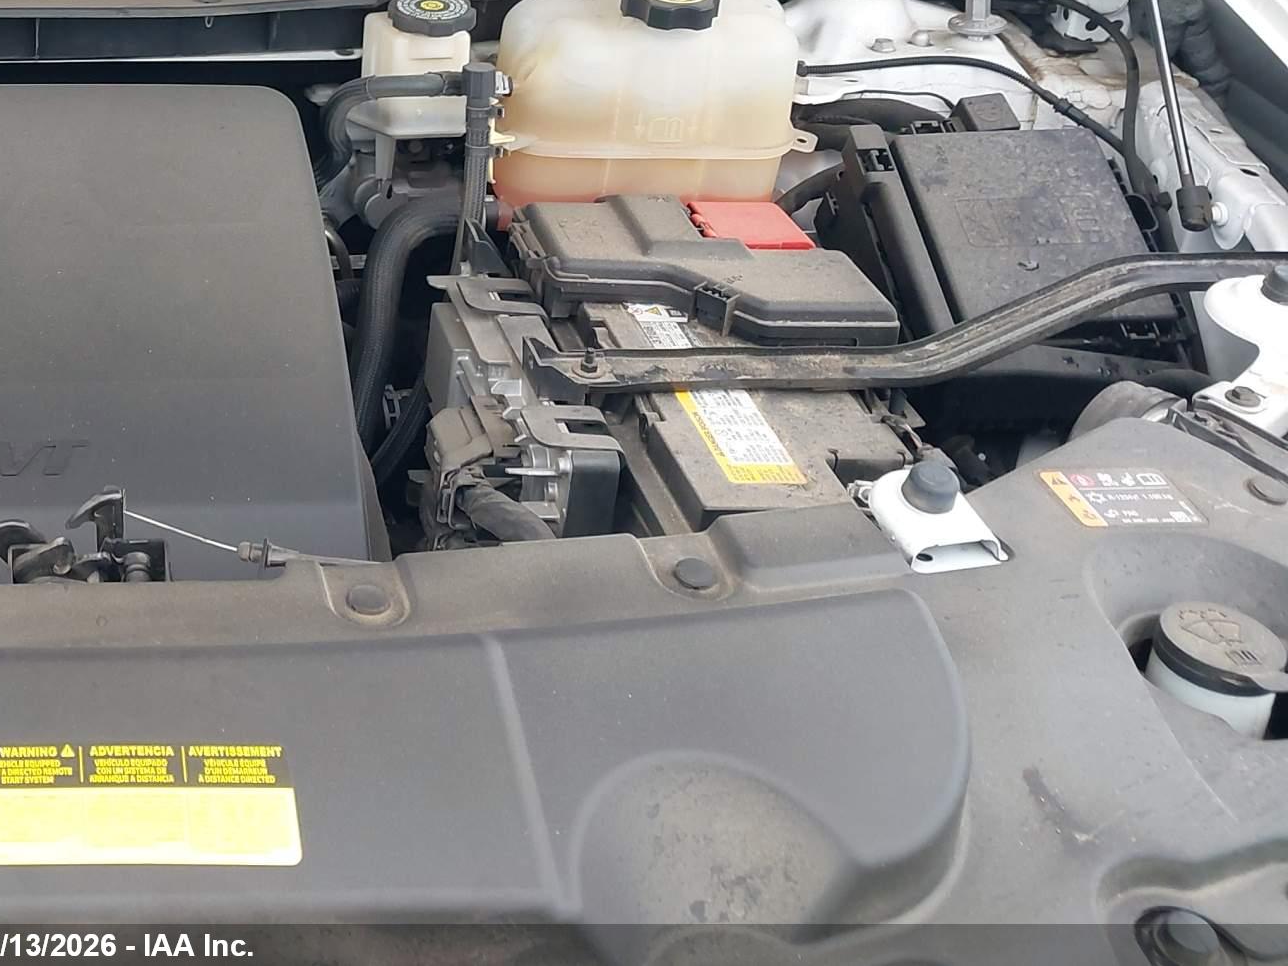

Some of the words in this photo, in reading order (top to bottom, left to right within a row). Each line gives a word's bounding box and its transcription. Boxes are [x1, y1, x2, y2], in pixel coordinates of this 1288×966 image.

[0, 746, 58, 758] WARNING
[90, 745, 175, 757] ADVERTENCIA
[189, 745, 282, 757] AVERTISSEMENT
[25, 759, 61, 768] EQUIPPED
[130, 758, 168, 767] EQUIPADO
[1, 767, 7, 776] A
[7, 767, 43, 776] DIRECTED
[43, 767, 72, 776] REMOTE
[96, 766, 112, 775] CON
[113, 766, 124, 775] UN
[124, 766, 156, 775] SISTEMA
[156, 766, 167, 775] DE
[1, 776, 23, 784] START
[24, 776, 54, 784] SYSTEM
[90, 774, 129, 783] ARRANQUE
[130, 775, 136, 783] A
[136, 774, 175, 783] DISTANCIA
[205, 775, 240, 783] DISTANCE
[240, 775, 276, 783] DIRECTED
